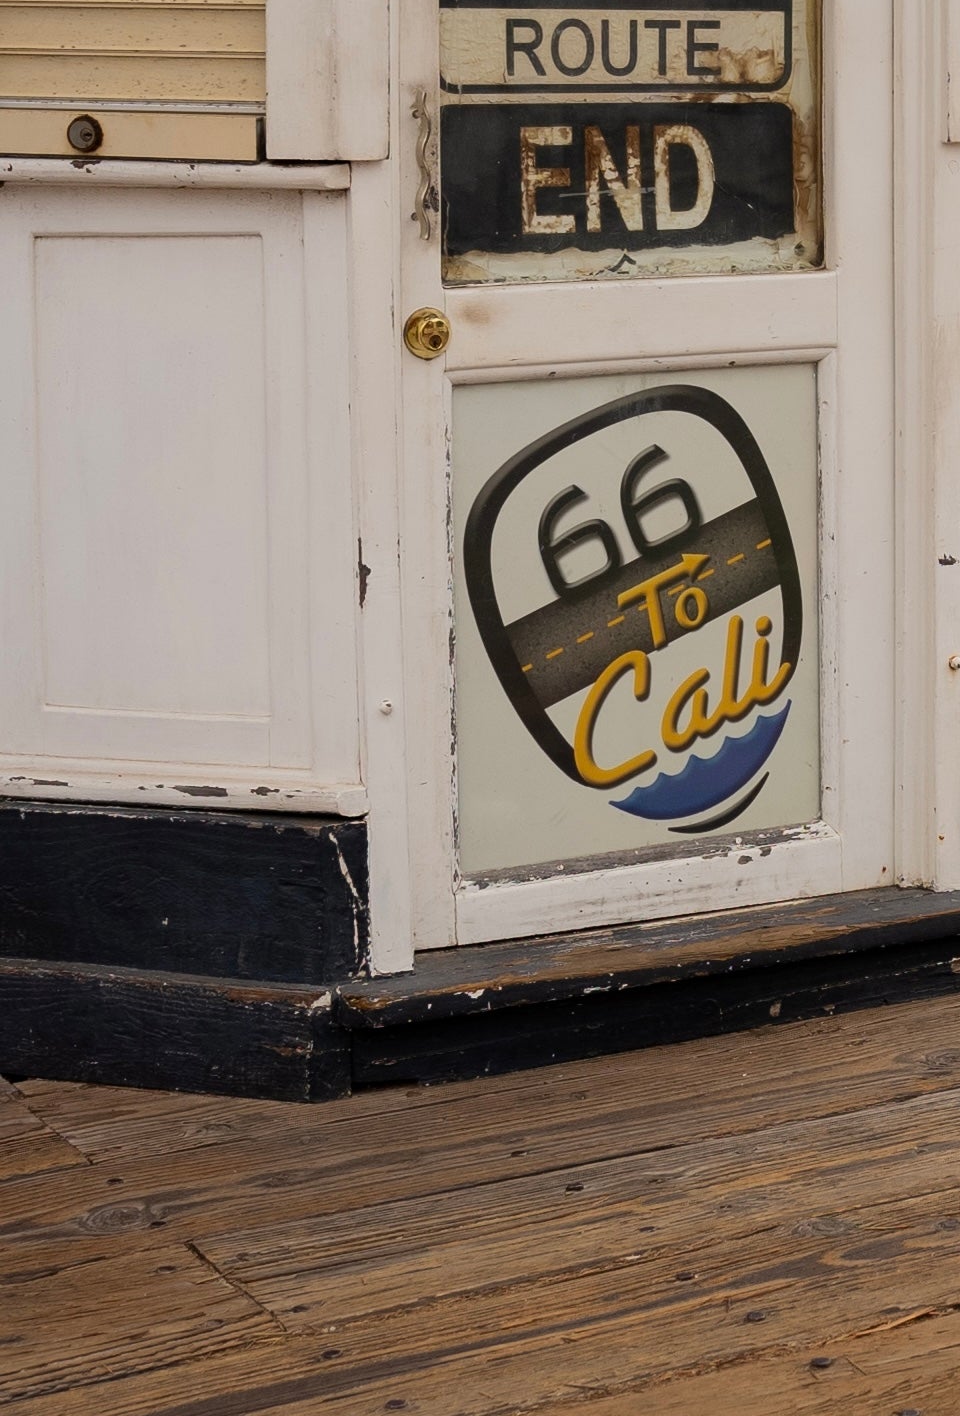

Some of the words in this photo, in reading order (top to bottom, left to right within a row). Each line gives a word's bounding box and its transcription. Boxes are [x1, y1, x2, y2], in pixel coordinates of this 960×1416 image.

[505, 18, 722, 77] ROUTE
[520, 125, 715, 234] END
[538, 444, 704, 600] 66
[617, 553, 711, 649] To
[574, 615, 791, 787] Cali
